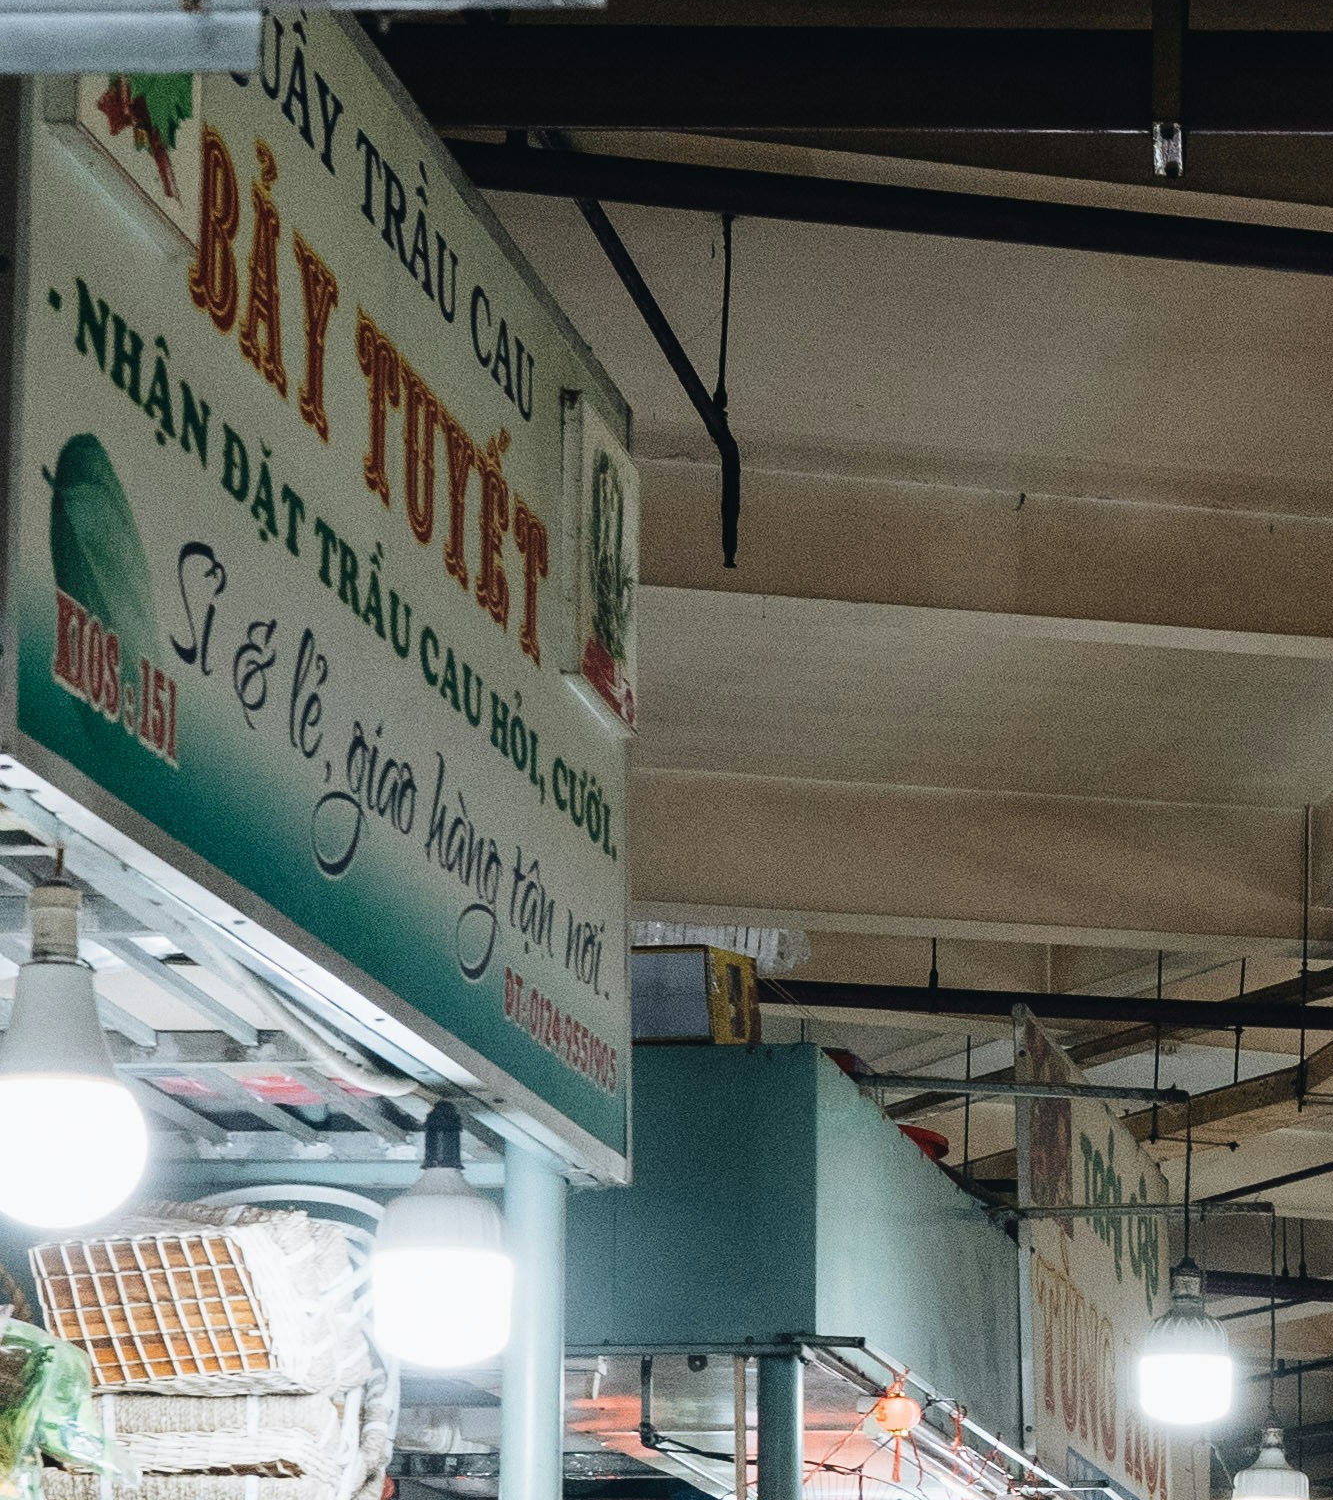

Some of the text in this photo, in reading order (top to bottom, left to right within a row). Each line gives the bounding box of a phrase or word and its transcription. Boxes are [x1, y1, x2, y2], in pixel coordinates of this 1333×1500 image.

[189, 120, 548, 668] BẢY TUYẾT
[230, 5, 534, 421] UẦY TRẦU CAU
[74, 277, 211, 474] NHẬN
[221, 434, 306, 556] ĐẶT
[314, 540, 408, 658] TRẦU
[420, 626, 482, 728] CAU
[233, 619, 278, 729] &
[137, 658, 178, 769] 151
